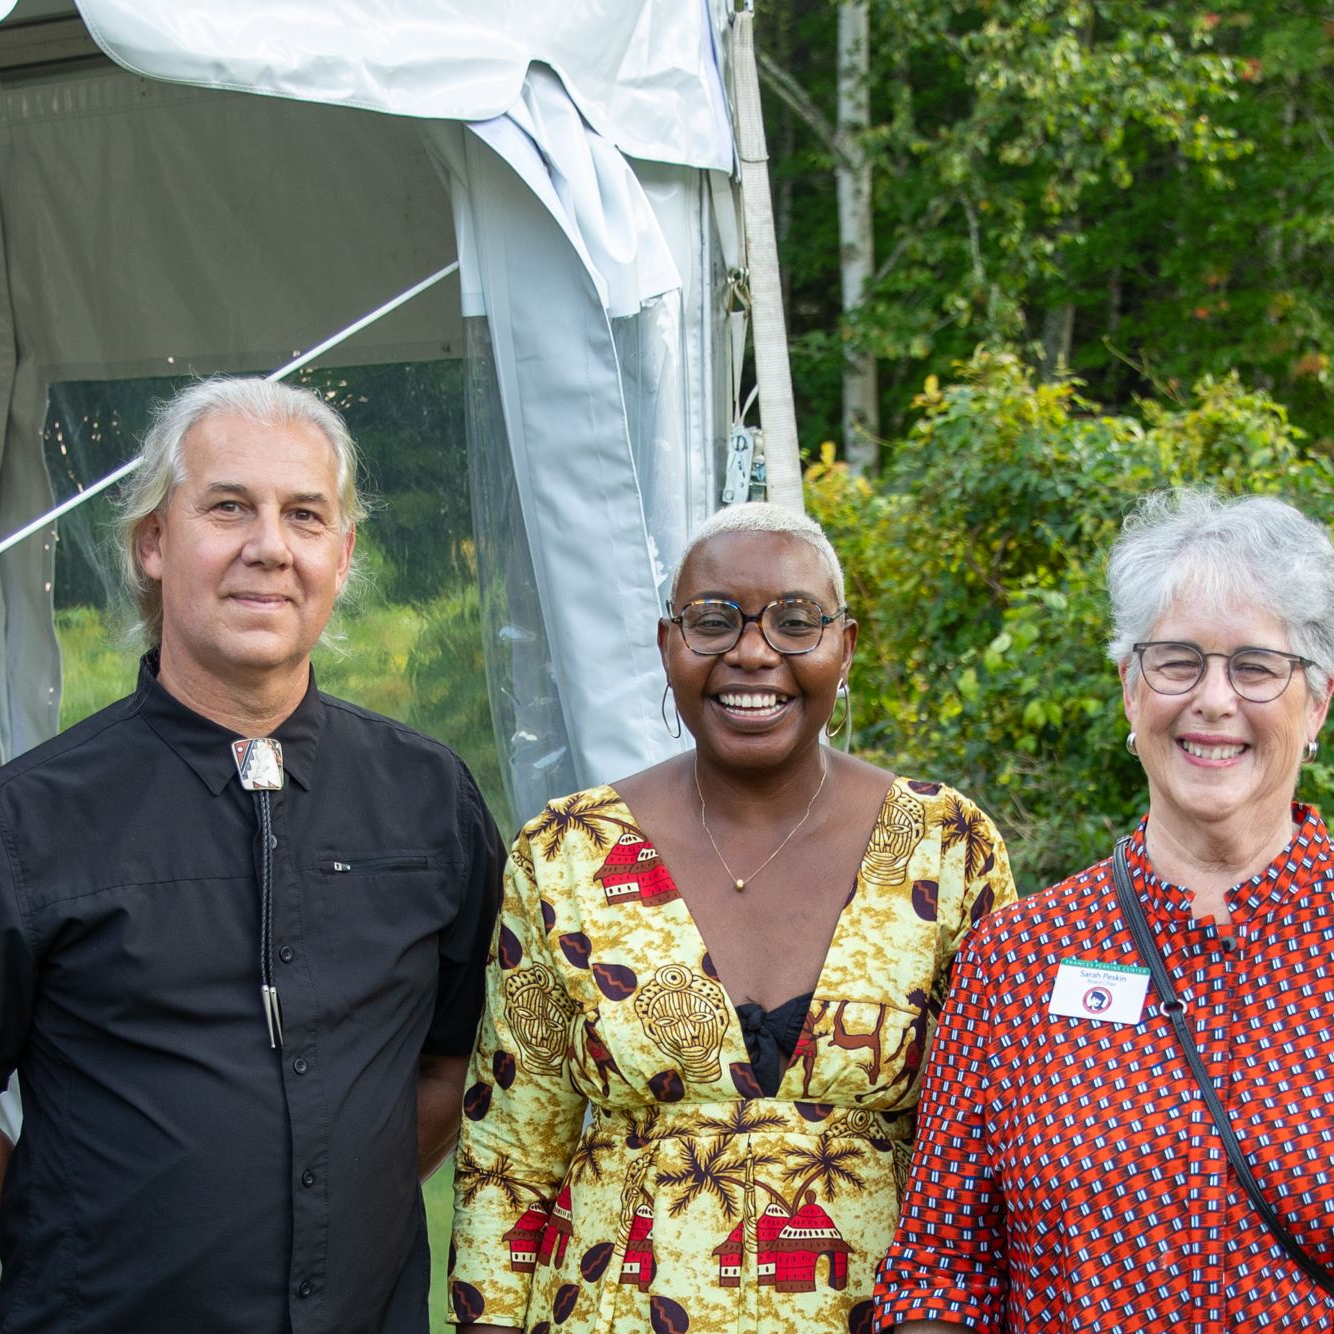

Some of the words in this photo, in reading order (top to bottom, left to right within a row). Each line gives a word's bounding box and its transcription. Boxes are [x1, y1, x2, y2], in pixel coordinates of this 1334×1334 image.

[1065, 960, 1094, 968] FRANCES
[1095, 963, 1121, 971] PERKINS
[1122, 966, 1147, 974] CENTER
[1080, 970, 1101, 979] Sarah
[1102, 972, 1127, 982] Peskin
